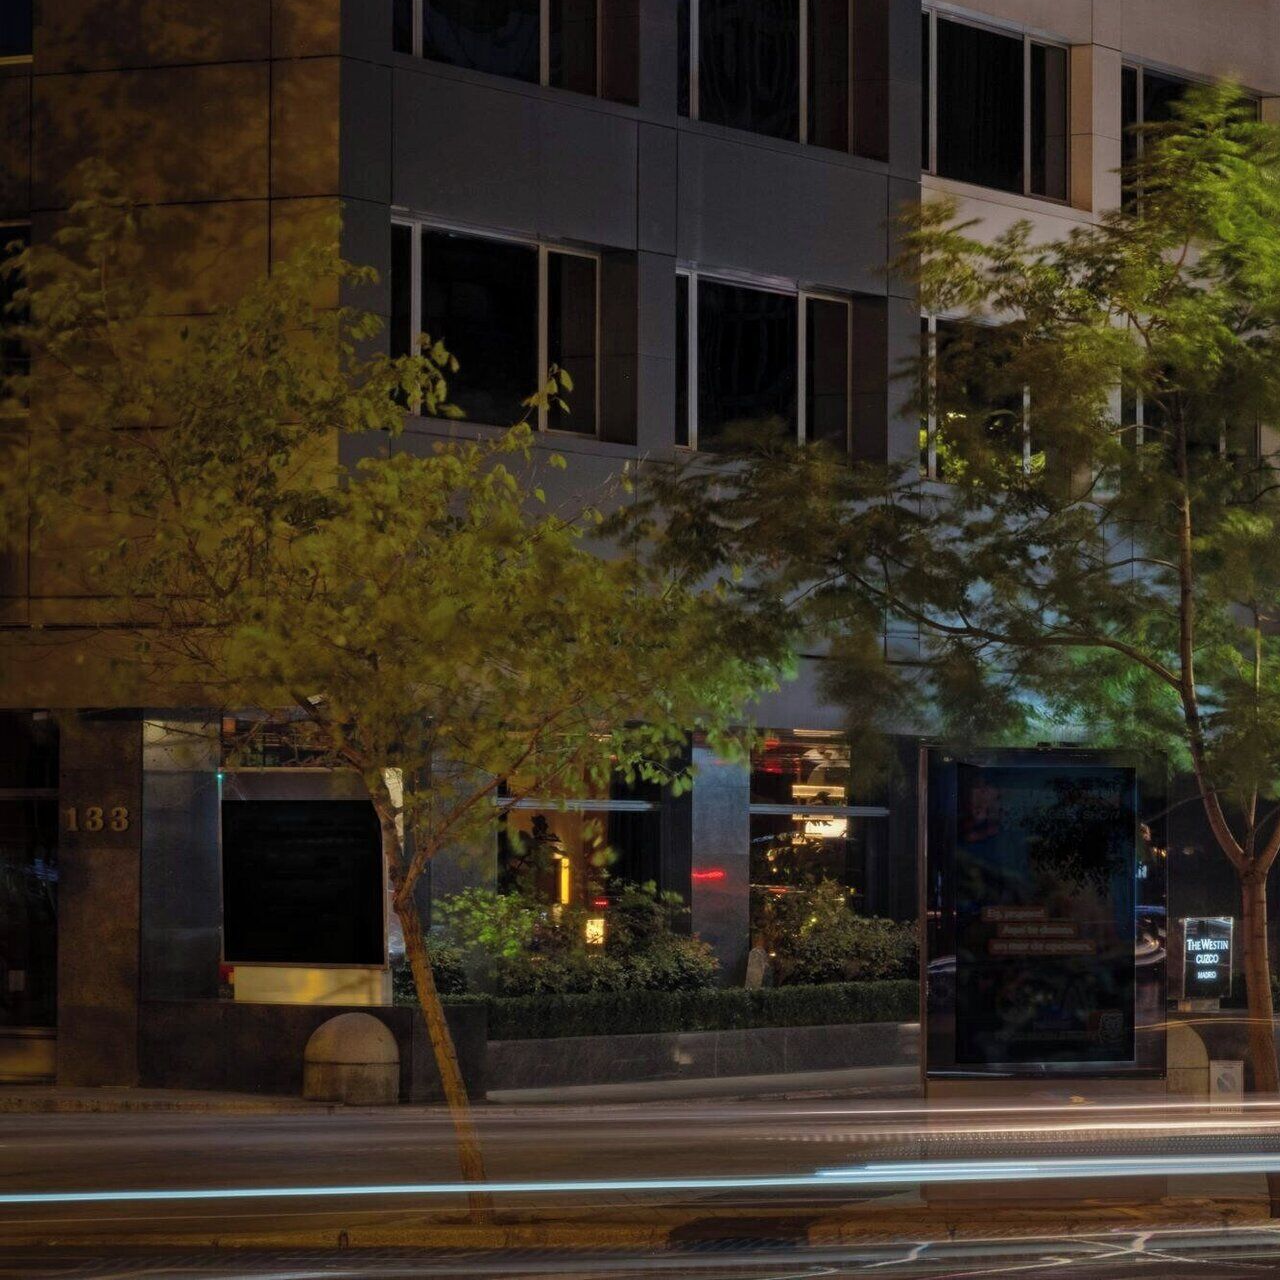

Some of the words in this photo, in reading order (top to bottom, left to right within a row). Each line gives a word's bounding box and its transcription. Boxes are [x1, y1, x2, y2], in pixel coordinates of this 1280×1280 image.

[63, 806, 129, 832] 133
[1187, 938, 1201, 951] THE
[1201, 938, 1229, 950] WESTIN
[1195, 954, 1220, 964] CUZCO
